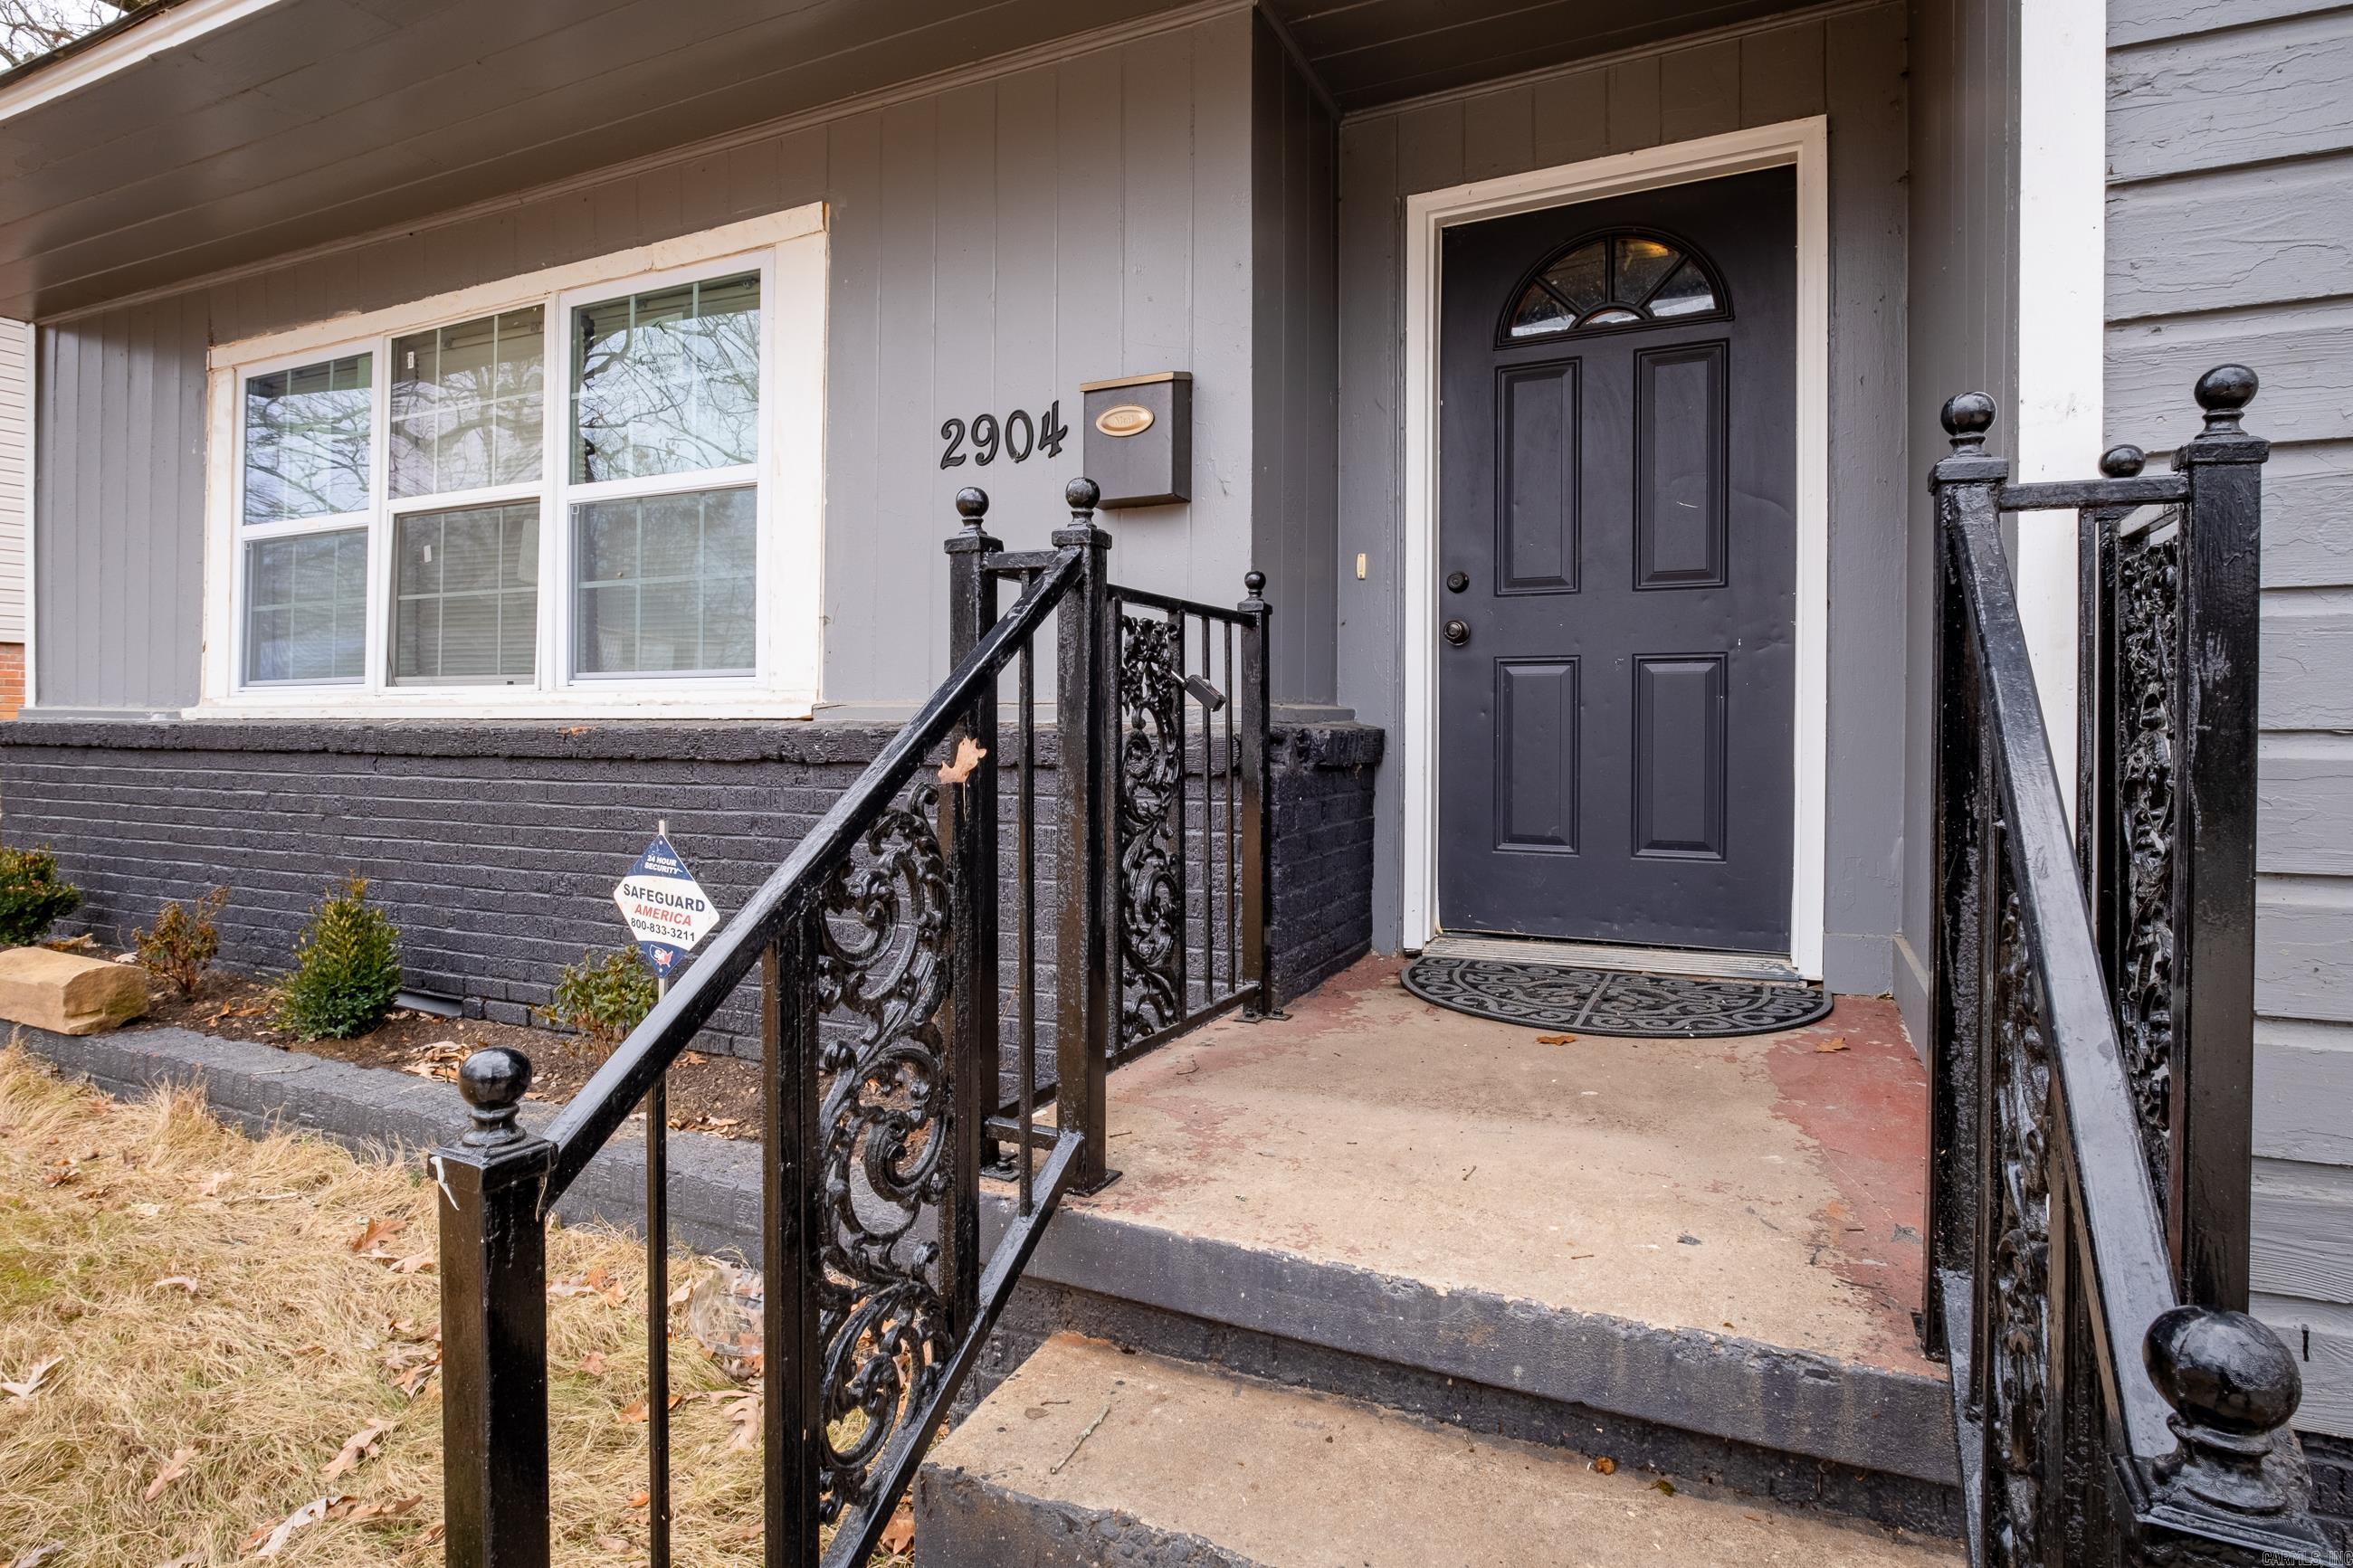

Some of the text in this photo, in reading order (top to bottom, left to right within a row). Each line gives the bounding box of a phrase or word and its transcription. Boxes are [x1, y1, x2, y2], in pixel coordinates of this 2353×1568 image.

[939, 399, 1069, 470] 2904
[644, 861, 679, 875] SECURITY
[646, 854, 677, 867] 24 HOUR
[624, 883, 705, 913] SAFEGUARD
[634, 904, 691, 927] AMERICA
[631, 917, 695, 942] 800-833-3211
